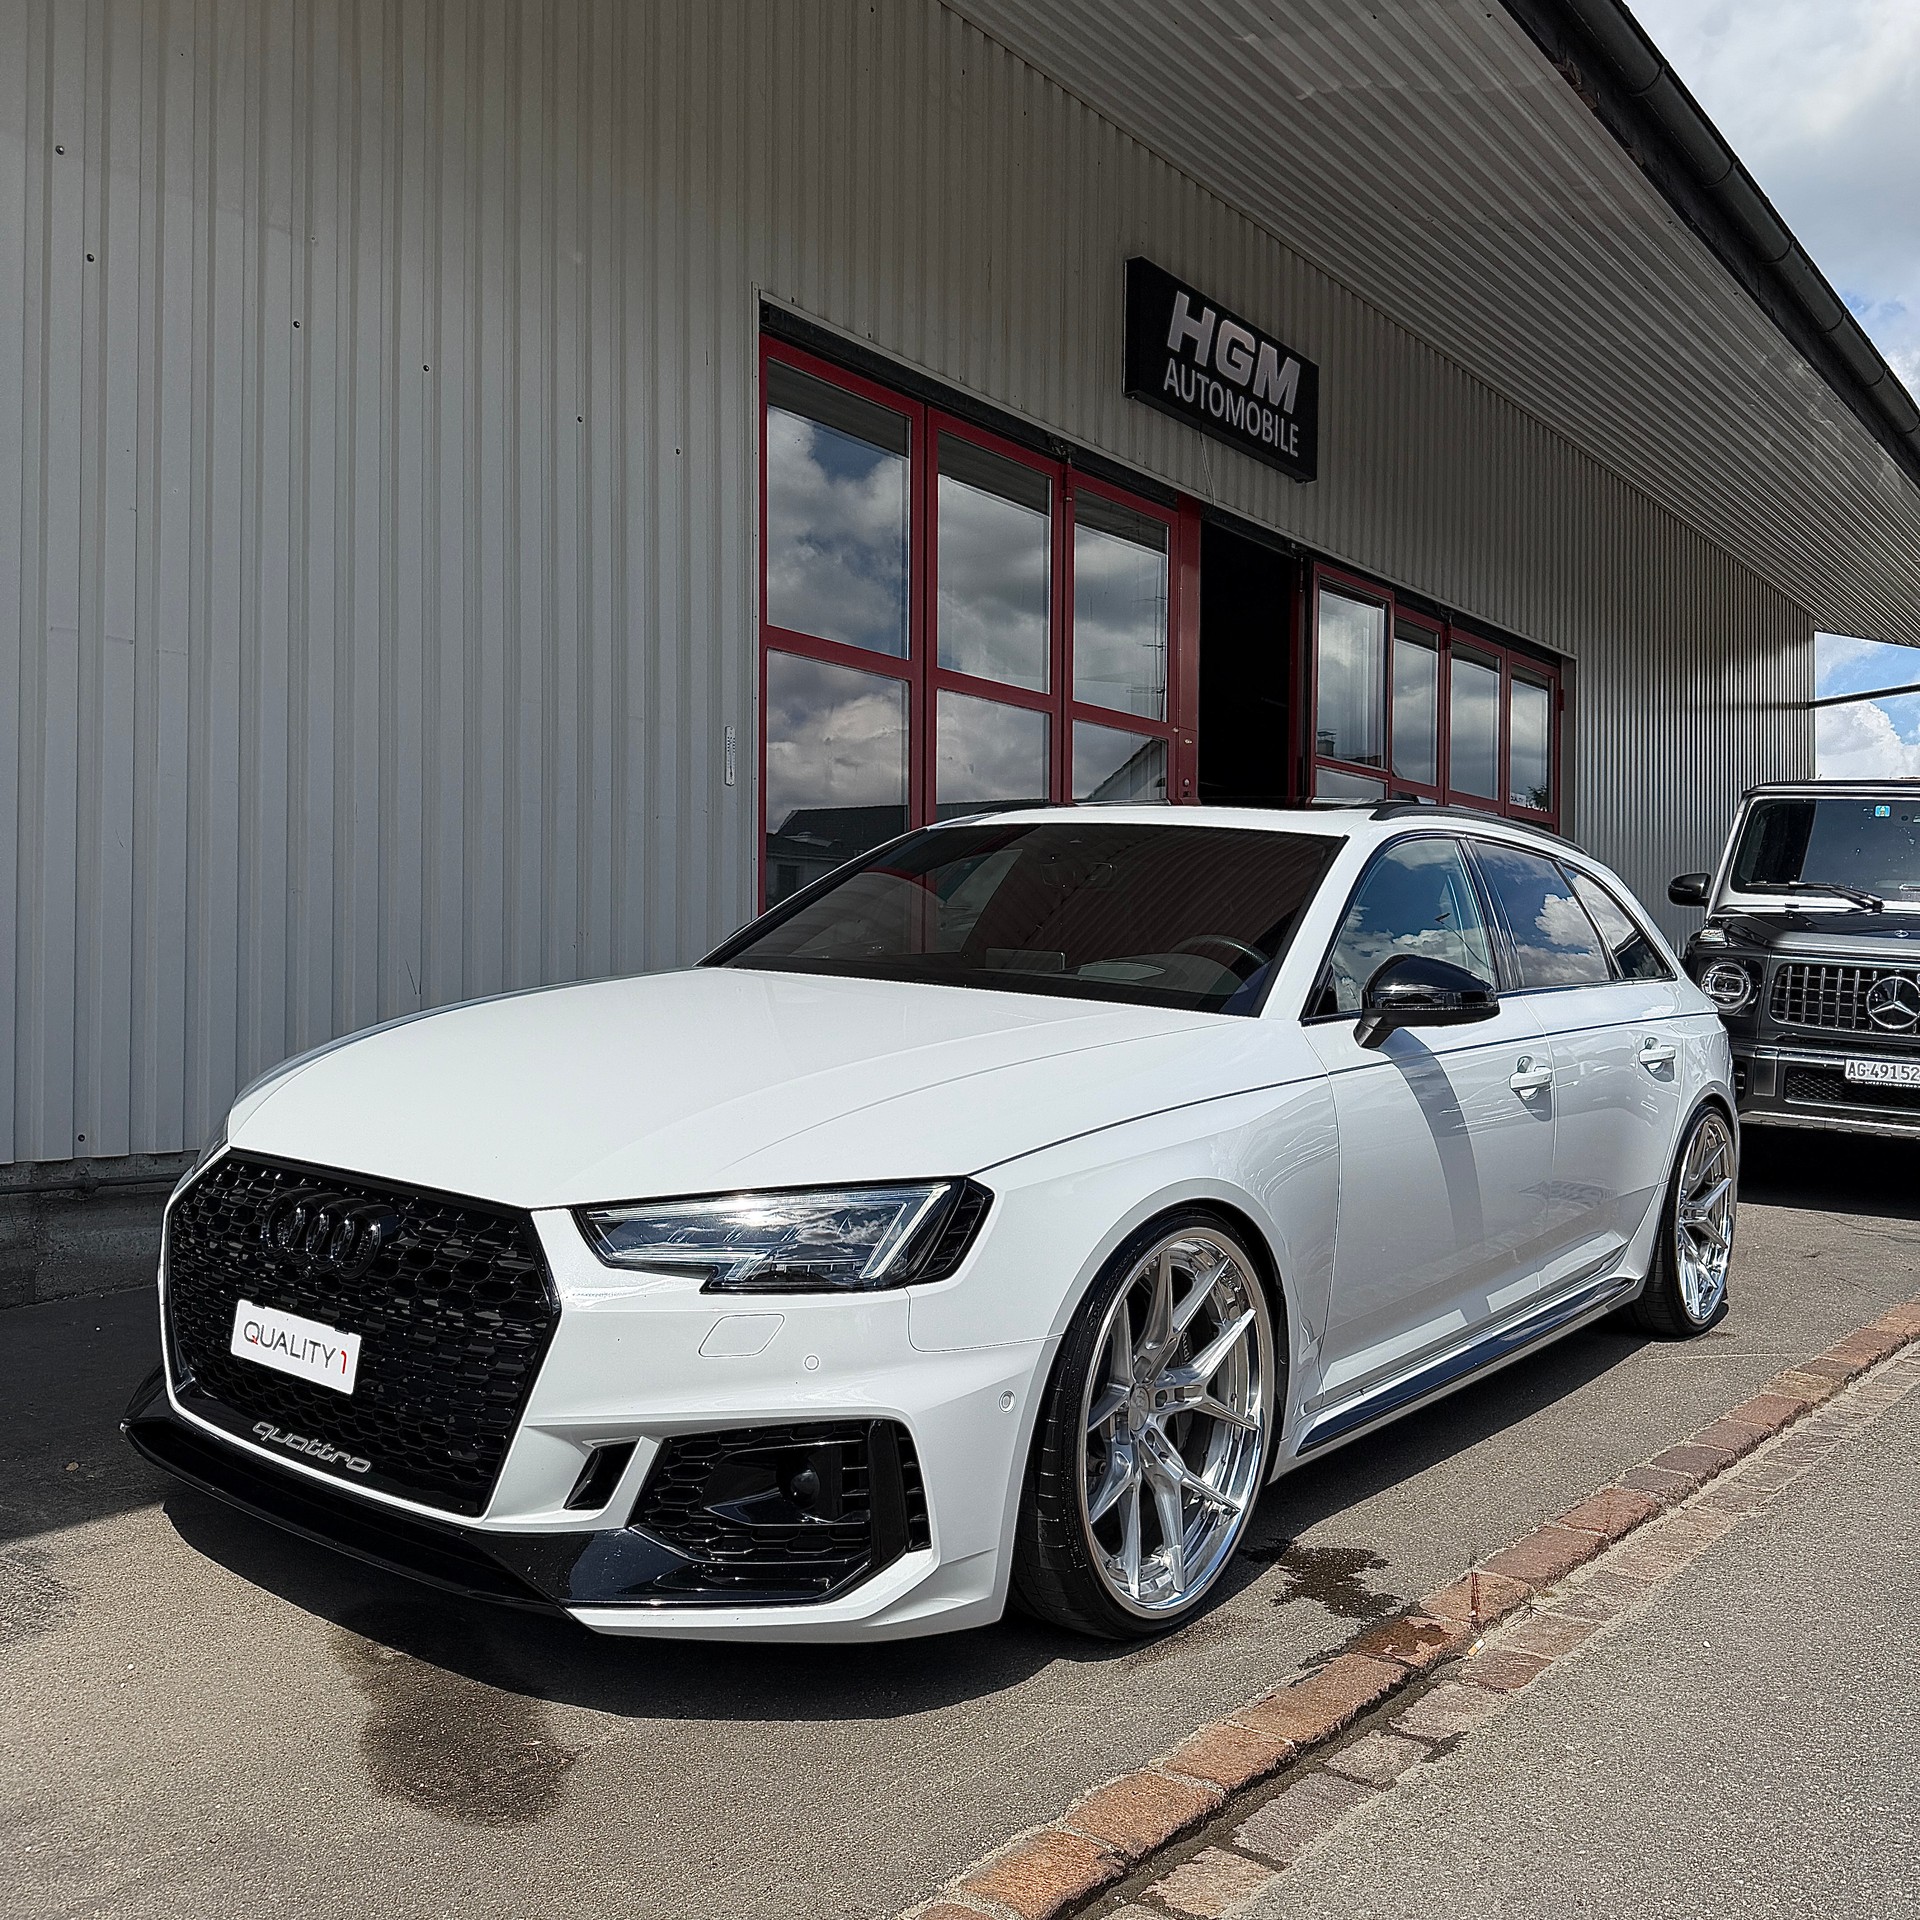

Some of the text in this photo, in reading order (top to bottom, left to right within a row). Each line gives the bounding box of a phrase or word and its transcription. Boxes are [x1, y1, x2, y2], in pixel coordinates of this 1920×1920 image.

[1167, 291, 1301, 414] HGM
[1164, 358, 1299, 457] AUTOMOBILE
[252, 1421, 371, 1473] quattro
